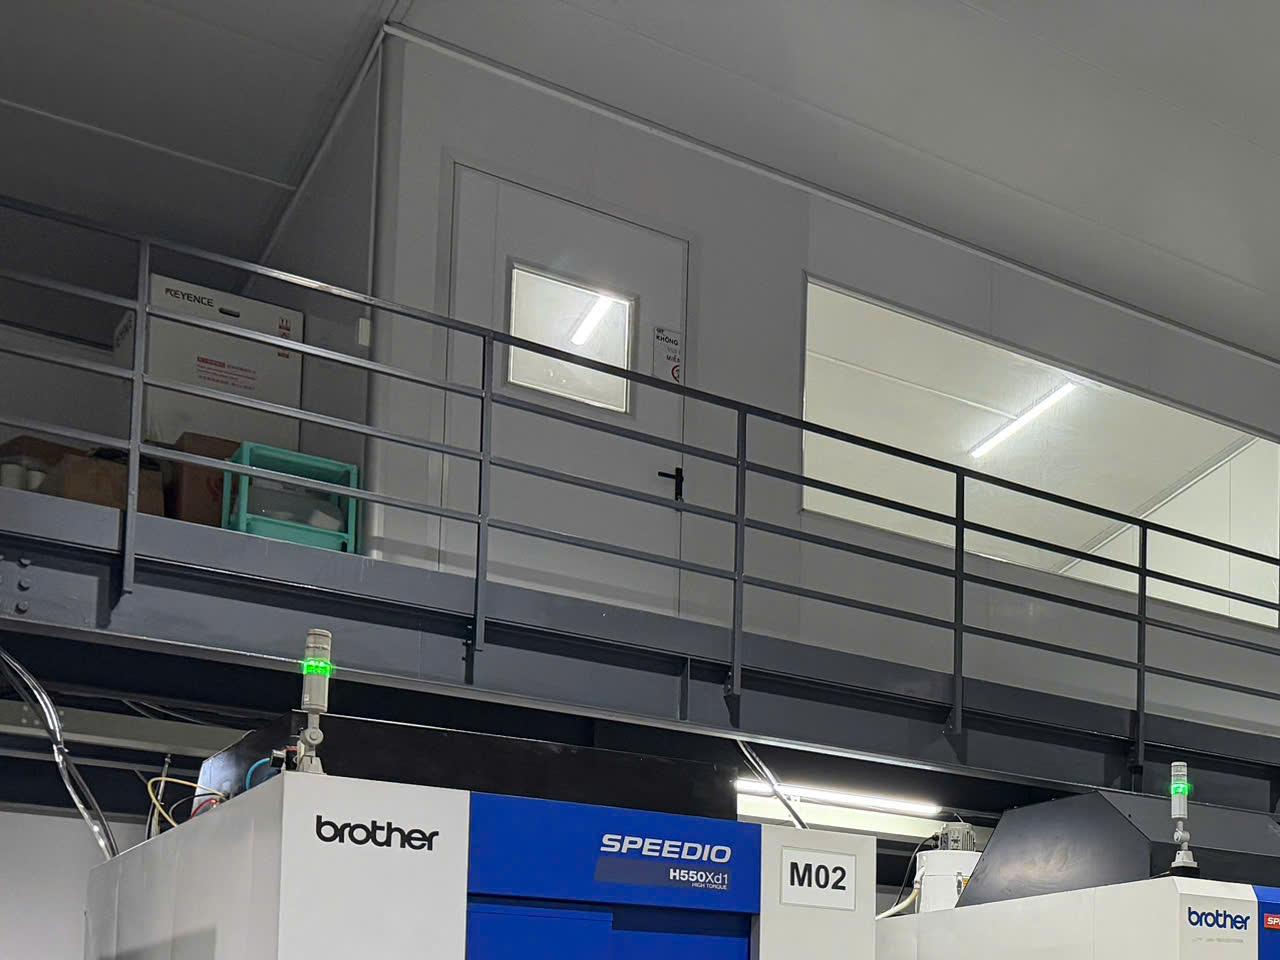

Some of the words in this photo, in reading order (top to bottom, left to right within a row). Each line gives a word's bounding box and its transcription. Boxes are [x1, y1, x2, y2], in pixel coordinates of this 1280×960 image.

[165, 287, 215, 308] KEYENCE
[316, 814, 440, 851] brother
[599, 833, 732, 863] SPEEDIO
[669, 868, 729, 884] H550Xd1
[789, 861, 847, 891] M02
[1187, 906, 1251, 930] brother
